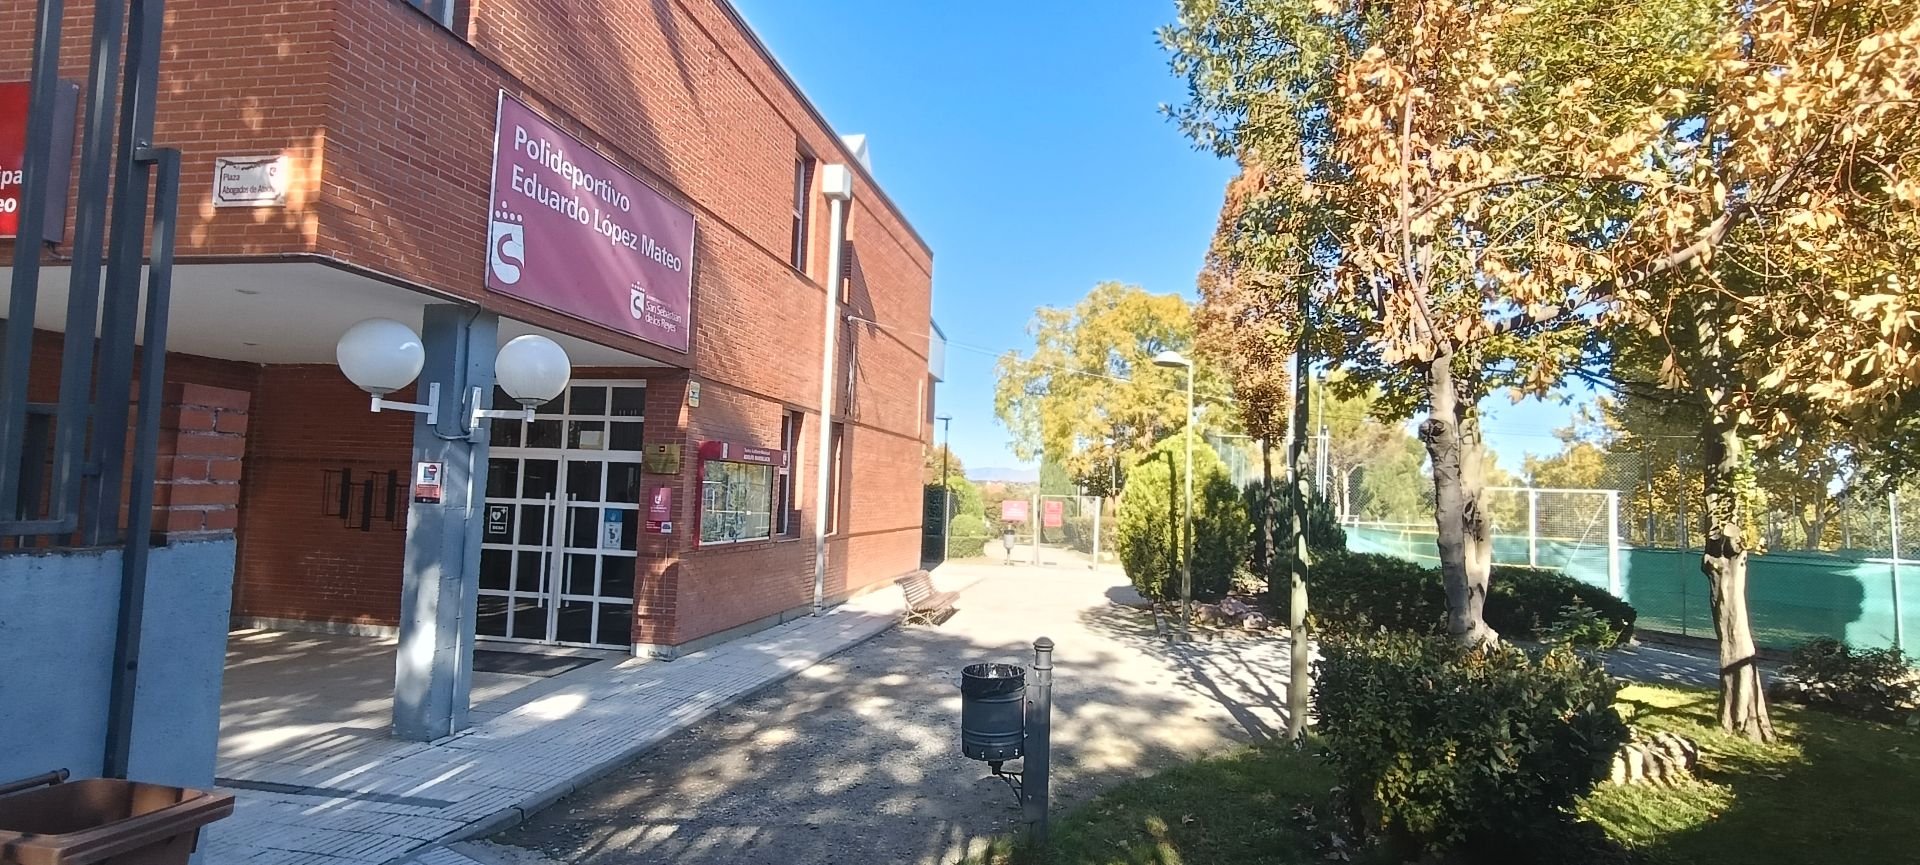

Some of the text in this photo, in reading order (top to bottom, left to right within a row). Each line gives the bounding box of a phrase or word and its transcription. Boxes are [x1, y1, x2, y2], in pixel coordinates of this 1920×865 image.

[514, 125, 631, 213] Polideportivo
[223, 173, 240, 181] Plaza
[222, 185, 276, 195] Abogados de Atoch
[511, 164, 682, 273] Eduardo López Mateo
[645, 300, 657, 314] San
[660, 318, 677, 332] Reyes
